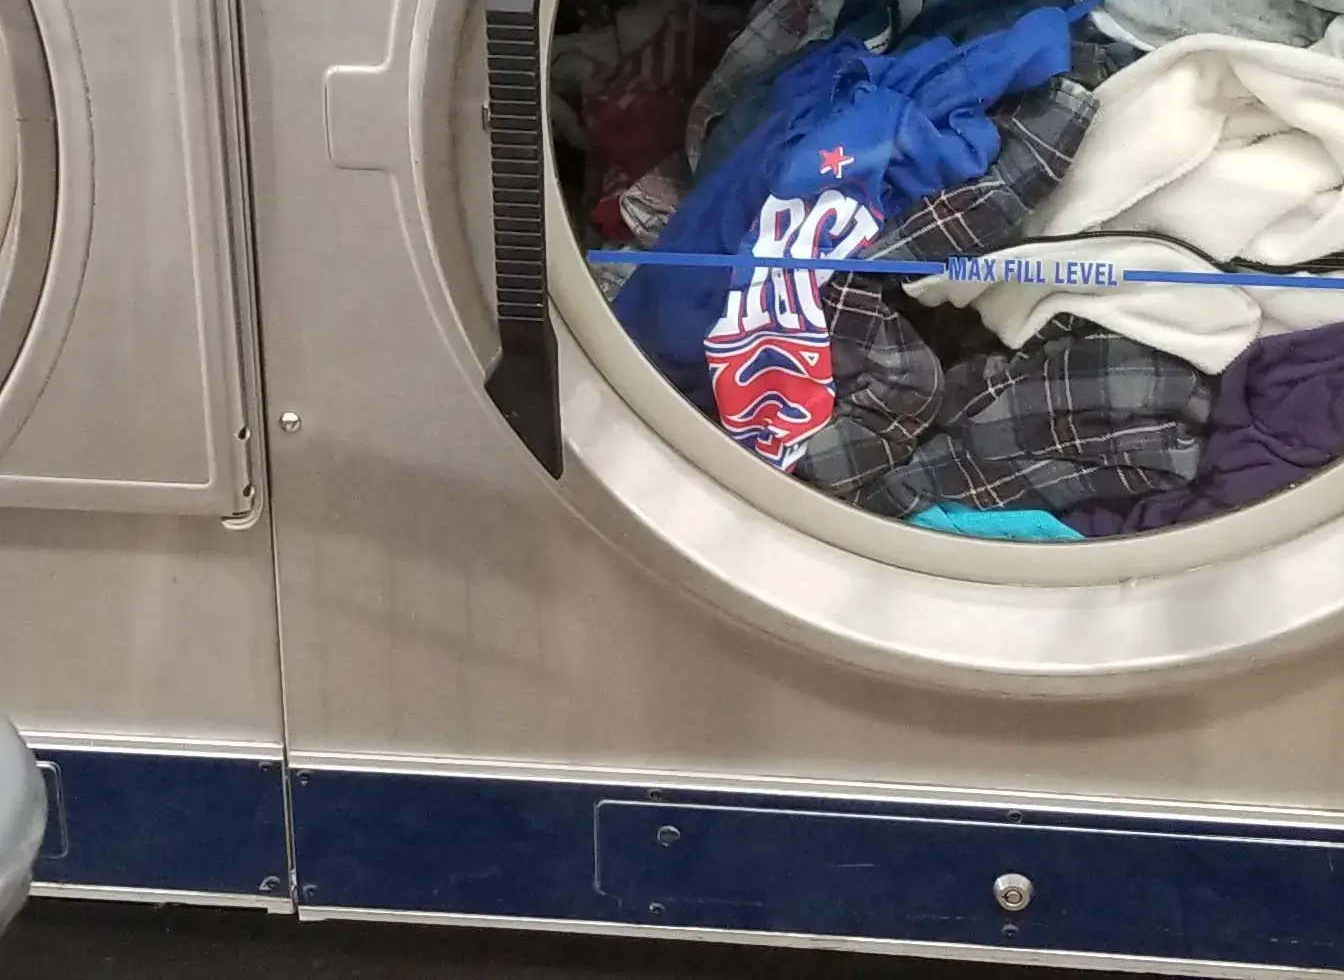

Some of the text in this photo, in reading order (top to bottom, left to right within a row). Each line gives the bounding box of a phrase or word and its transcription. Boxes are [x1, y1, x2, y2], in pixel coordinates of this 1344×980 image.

[948, 255, 1118, 287] MAX FILL LEVEL
